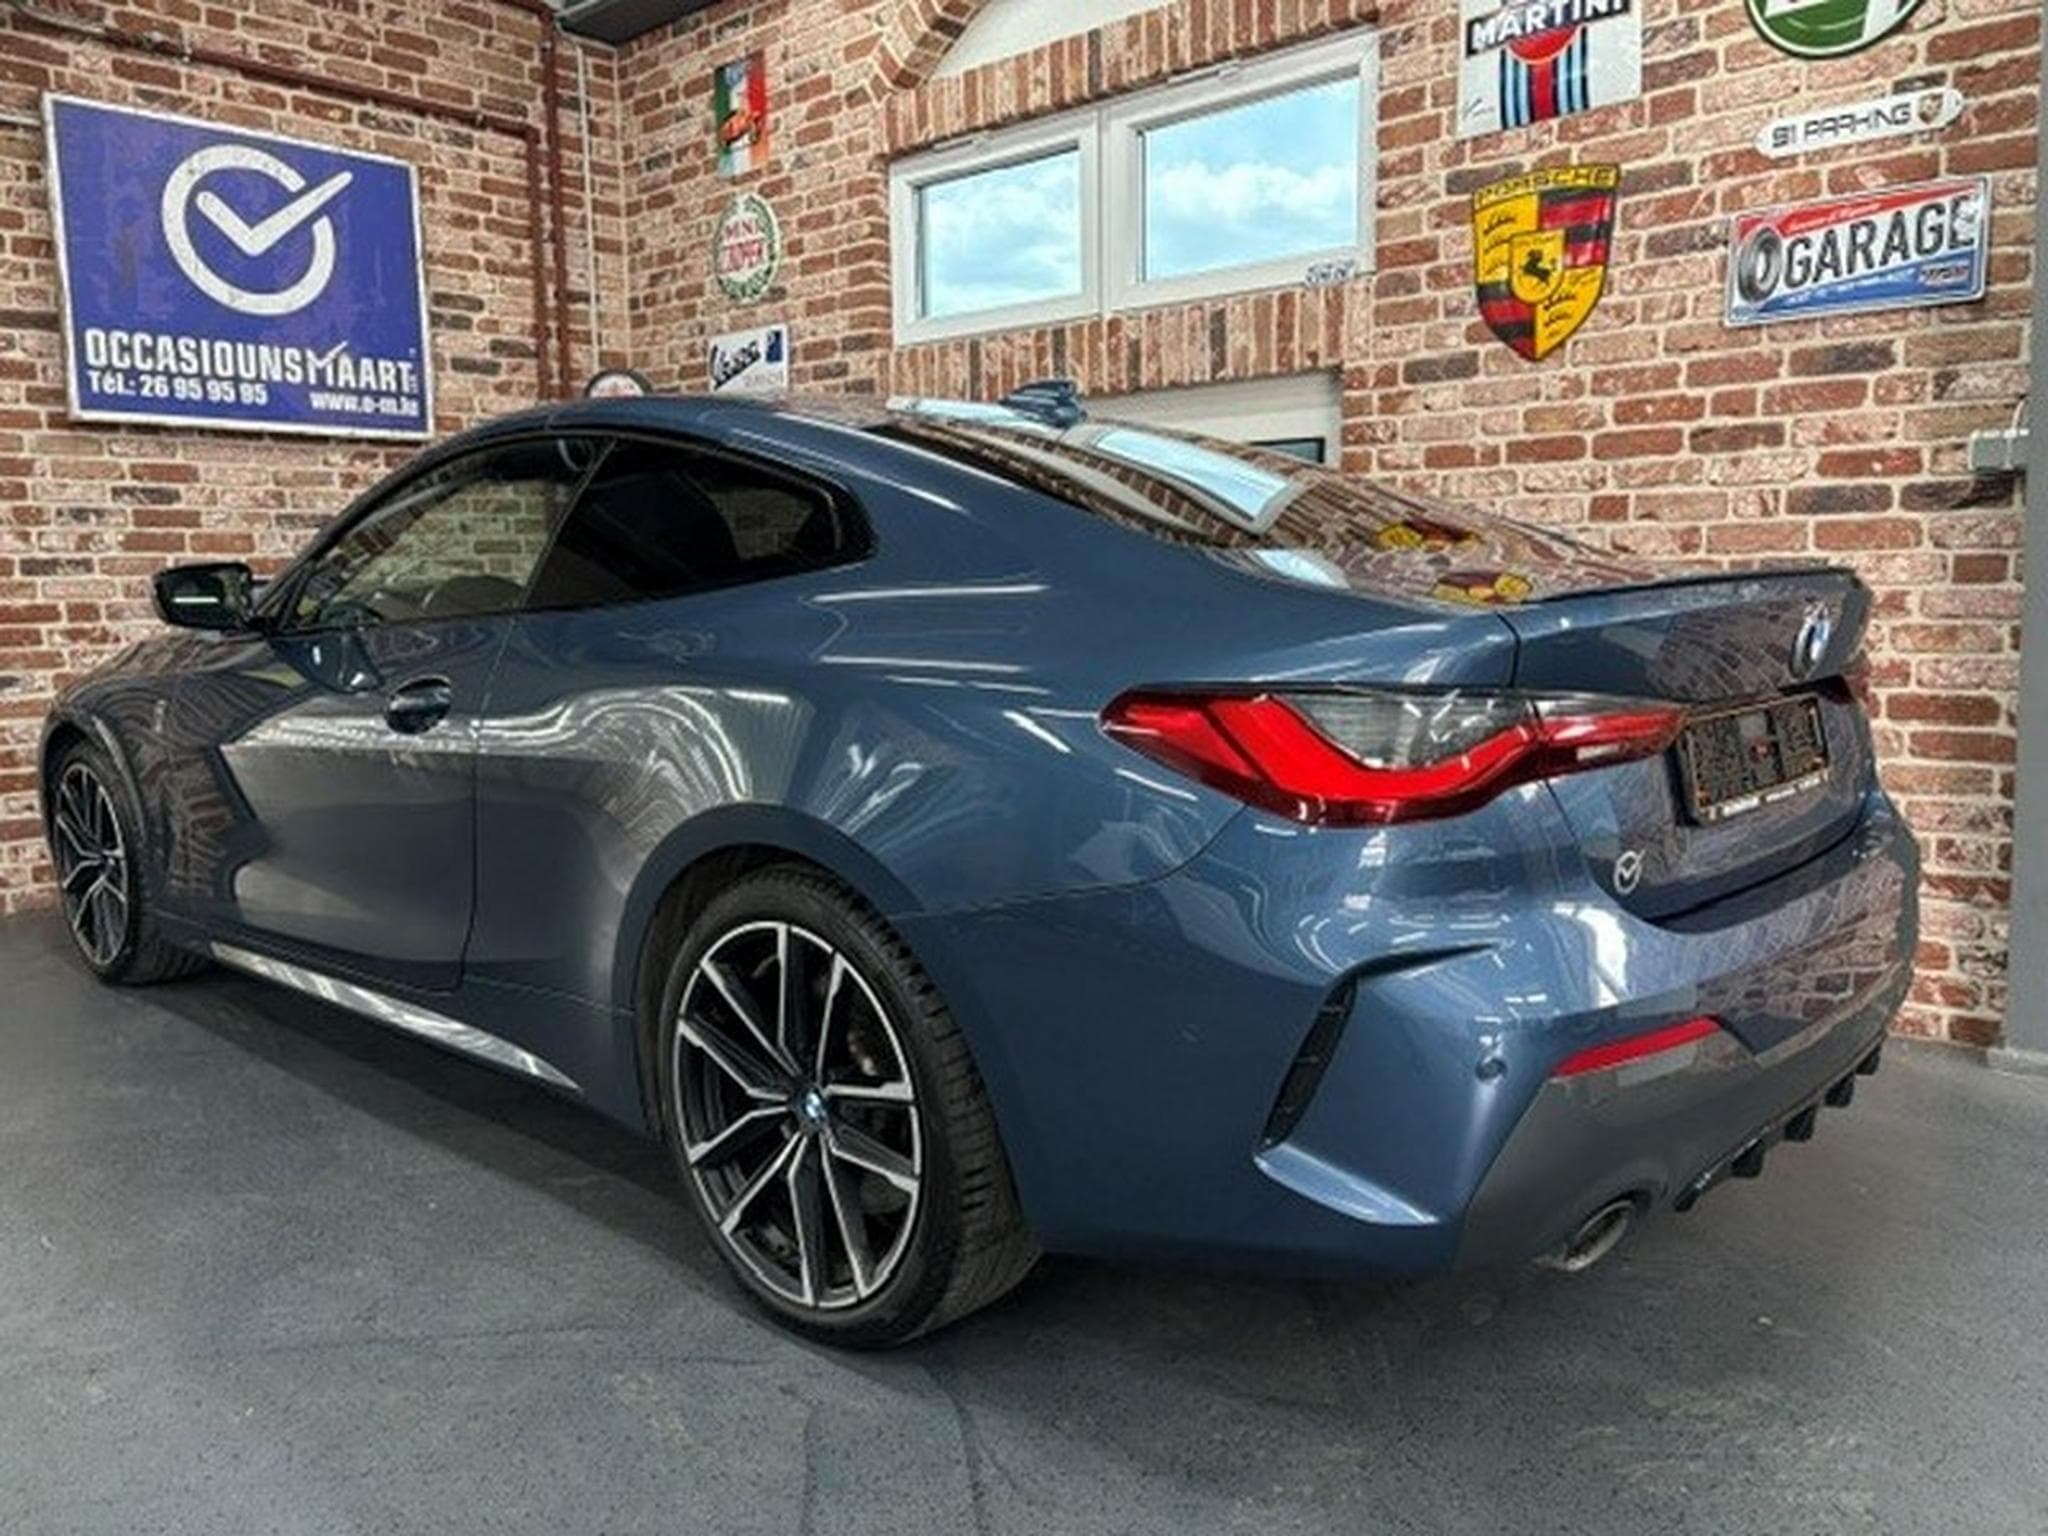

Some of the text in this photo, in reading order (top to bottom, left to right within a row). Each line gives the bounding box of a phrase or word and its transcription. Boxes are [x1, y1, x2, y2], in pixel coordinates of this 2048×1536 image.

[1783, 196, 1977, 289] GARAGE
[139, 374, 170, 398] 26
[173, 376, 203, 401] 95
